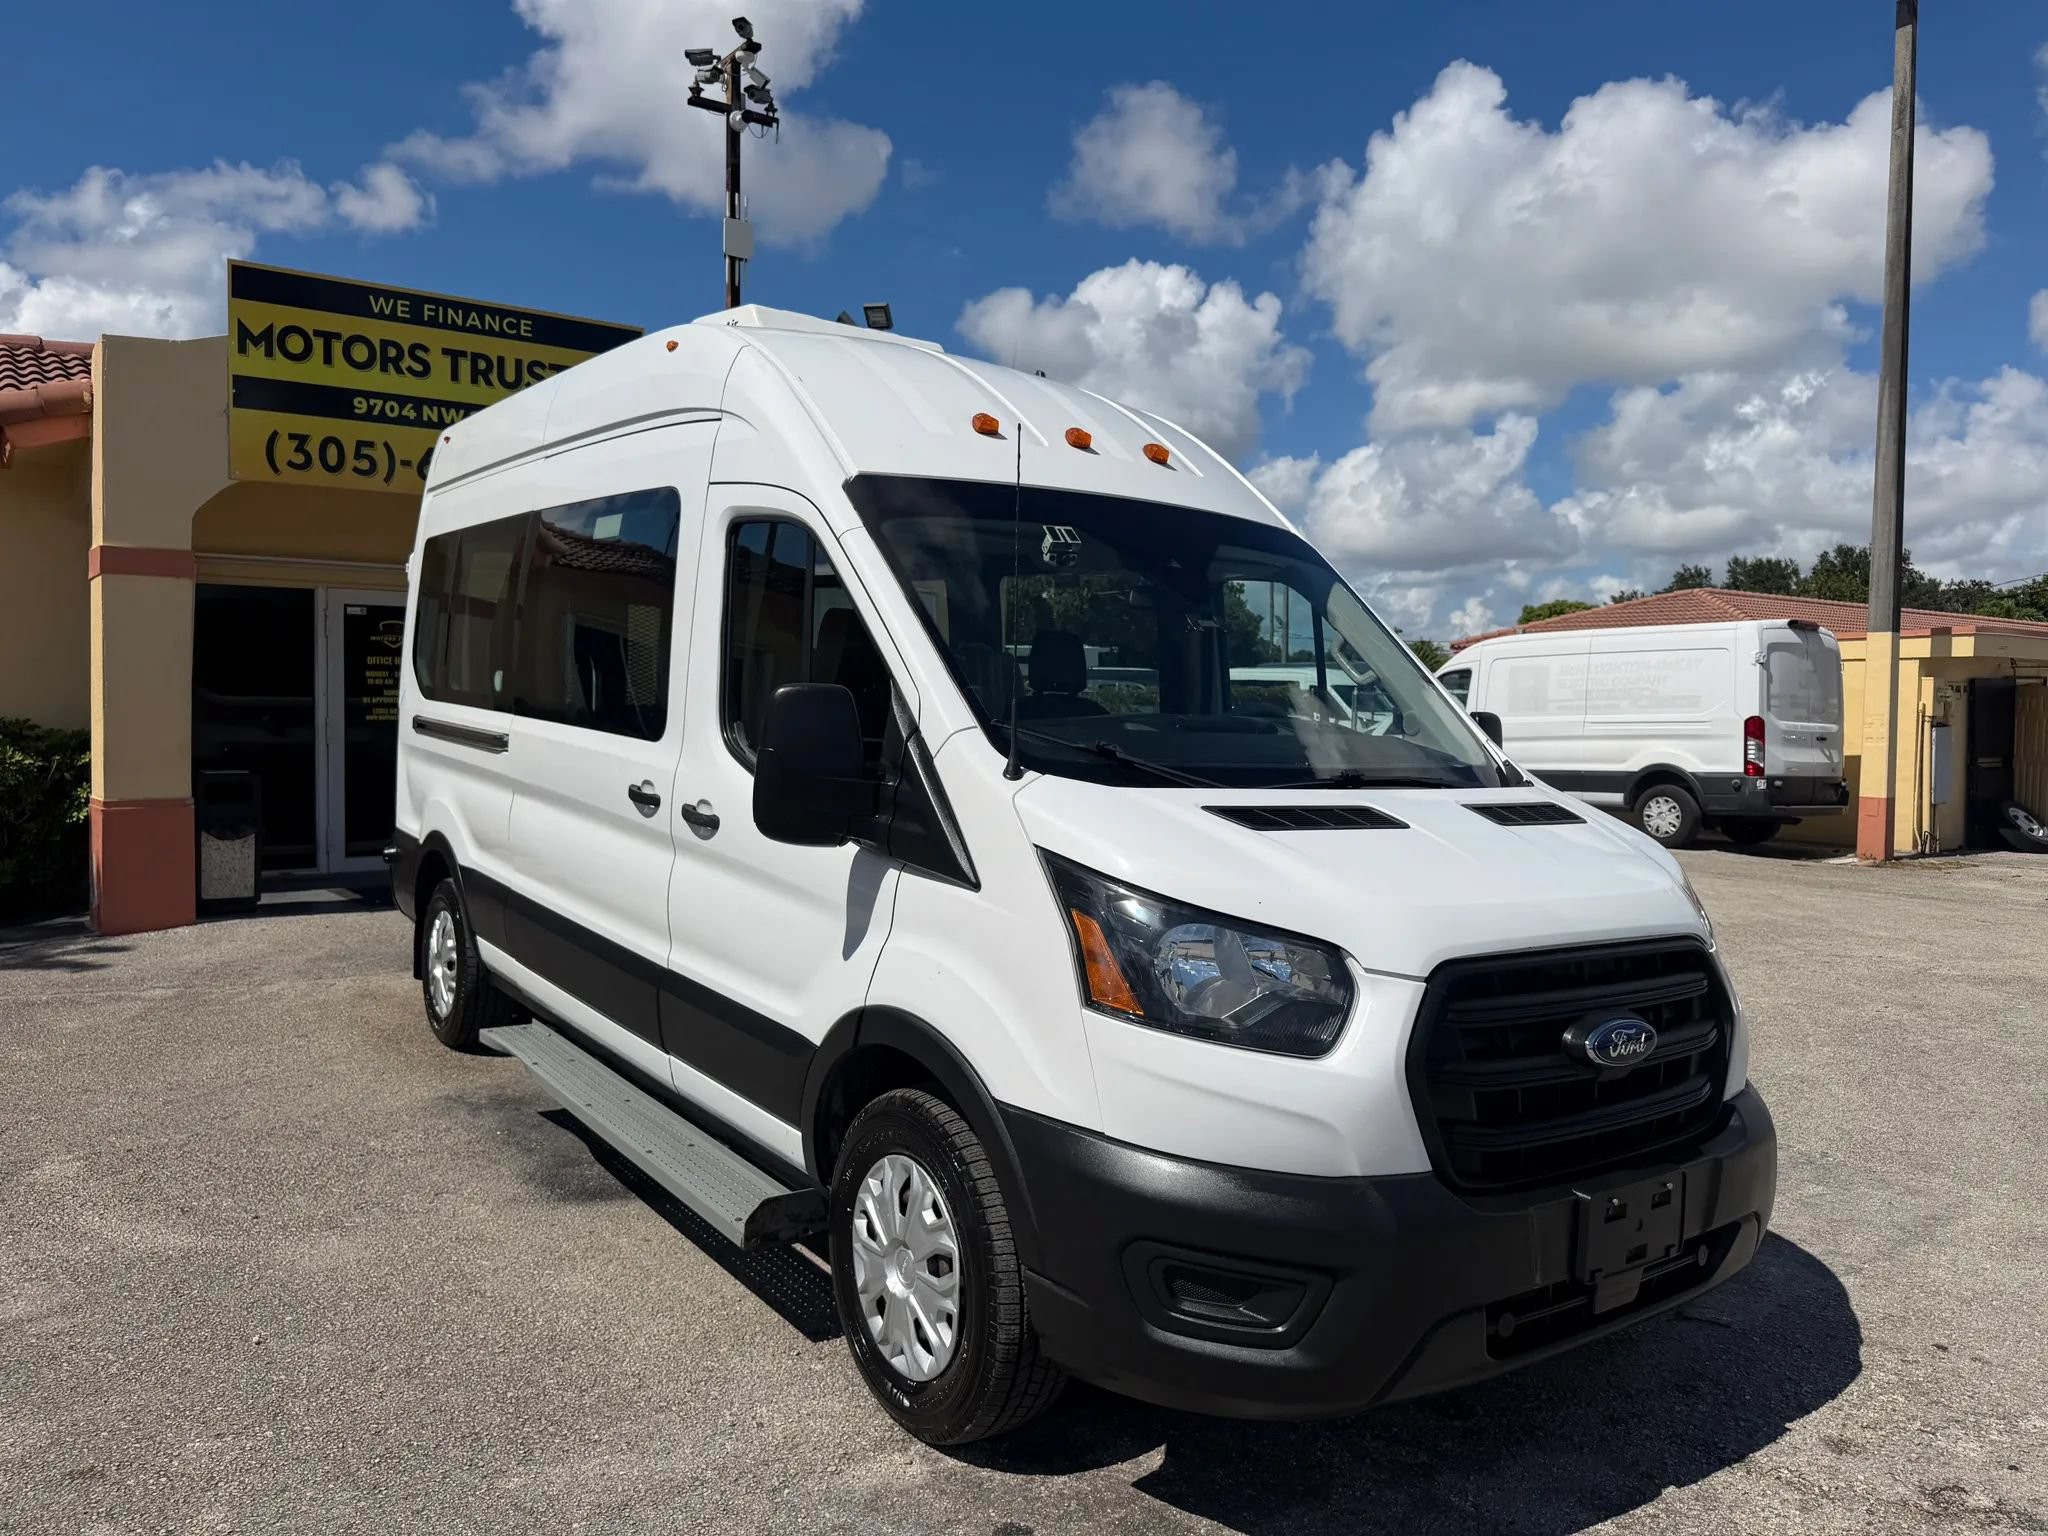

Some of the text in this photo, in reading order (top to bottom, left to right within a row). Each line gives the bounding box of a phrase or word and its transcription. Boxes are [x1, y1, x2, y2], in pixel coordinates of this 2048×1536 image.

[369, 295, 533, 337] WE FINANCE
[237, 317, 572, 391] MOTORS TRUS
[352, 396, 465, 424] 9704 NW
[1609, 1028, 1649, 1058] Ford
